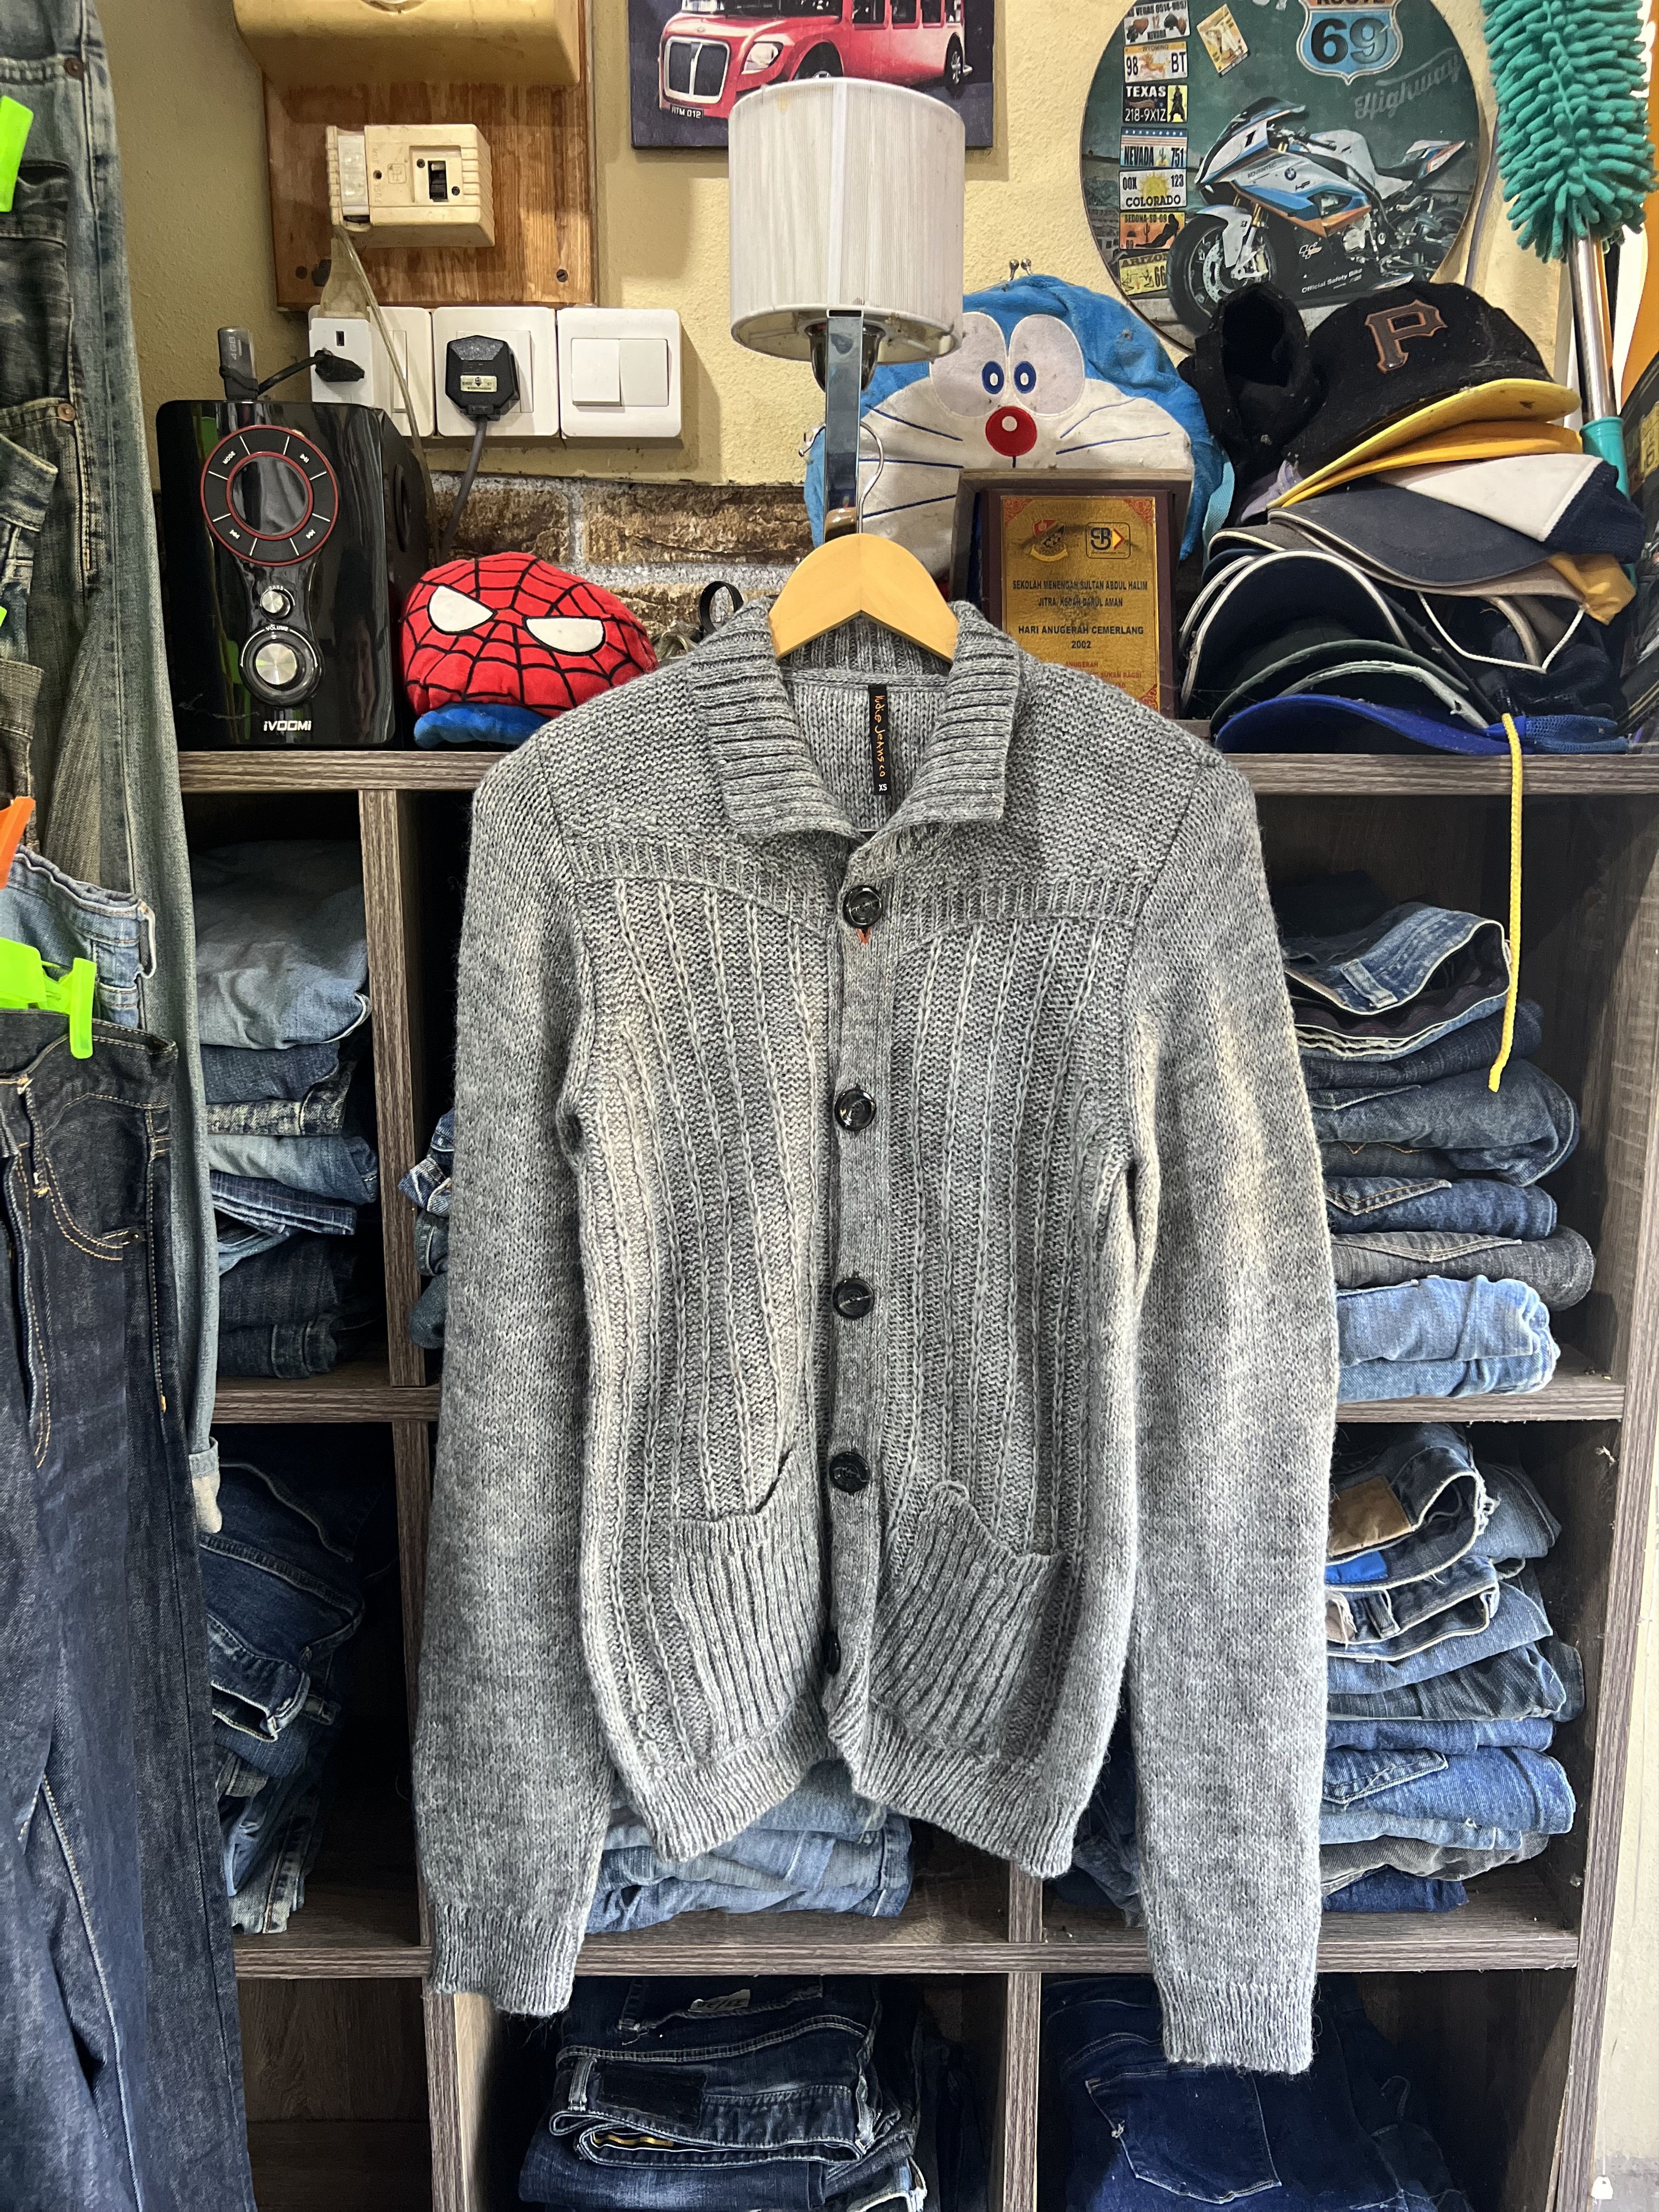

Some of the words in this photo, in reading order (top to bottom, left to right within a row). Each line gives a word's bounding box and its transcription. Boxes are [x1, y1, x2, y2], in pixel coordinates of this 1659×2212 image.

[1311, 18, 1388, 64] 69
[1142, 44, 1169, 52] WYOMING
[1126, 56, 1138, 76] 98
[1171, 51, 1185, 73] BT
[1355, 49, 1463, 119] Highway
[1126, 86, 1167, 97] TEXAS
[1244, 130, 1257, 147] 1
[1124, 146, 1154, 165] NEVADA
[1171, 147, 1184, 167] 751
[1171, 174, 1184, 187] 123
[1126, 195, 1181, 207] COLORADO
[1121, 253, 1168, 268] ARIZON
[1302, 281, 1326, 293] Official
[1327, 274, 1348, 285] Safety
[1365, 299, 1448, 374] P
[223, 451, 236, 464] MODE
[1012, 581, 1041, 589] SEKOLAH
[1044, 581, 1078, 590] MENENGAH
[1080, 581, 1104, 590] SULTAN
[1106, 581, 1127, 590] ABDUL
[1129, 581, 1148, 590] HALIM
[1083, 597, 1103, 607] DARUL
[1105, 598, 1123, 607] AMAN
[1041, 626, 1089, 634] ANUGERAH
[1092, 626, 1144, 634] CEMERLANG
[1071, 641, 1091, 649] 2002
[878, 783, 888, 792] XS
